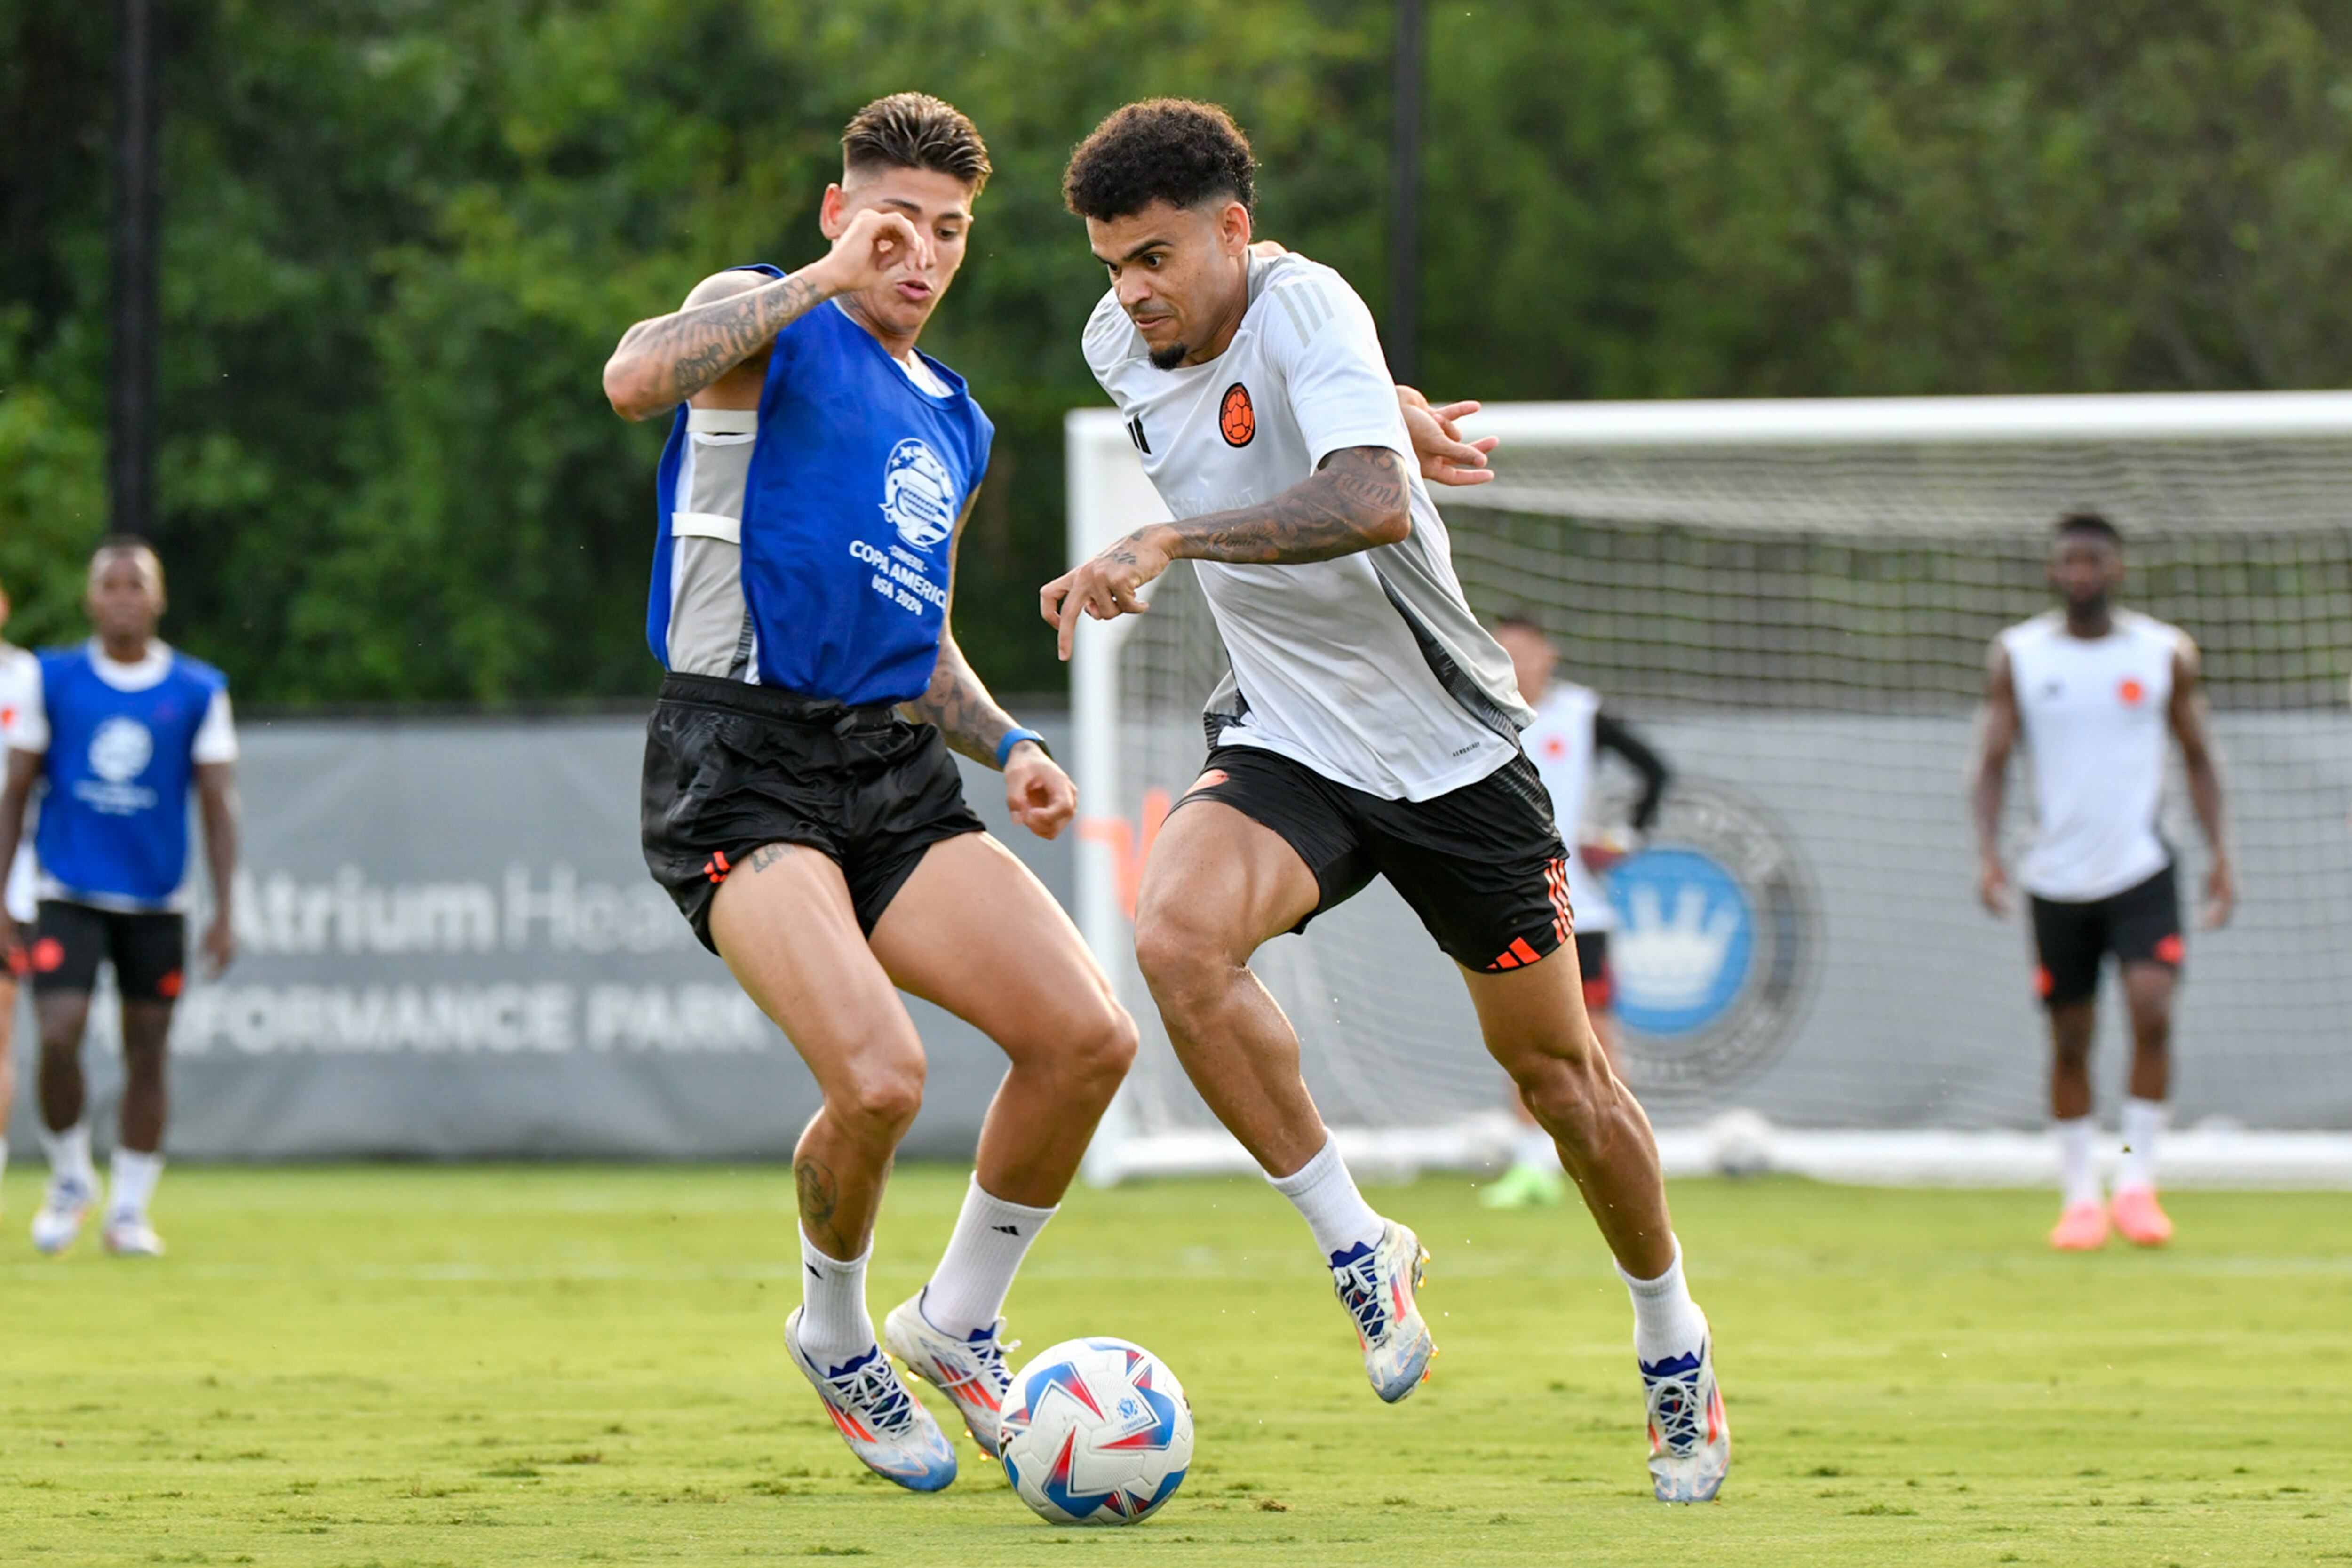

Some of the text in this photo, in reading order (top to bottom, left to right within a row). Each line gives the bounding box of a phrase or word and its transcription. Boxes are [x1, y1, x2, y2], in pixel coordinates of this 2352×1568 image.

[849, 540, 889, 574] COPA
[889, 563, 947, 610] AMERIC
[872, 574, 923, 616] USA 2024
[503, 859, 694, 955] Hea
[172, 981, 774, 1055] FORMANCE PARK
